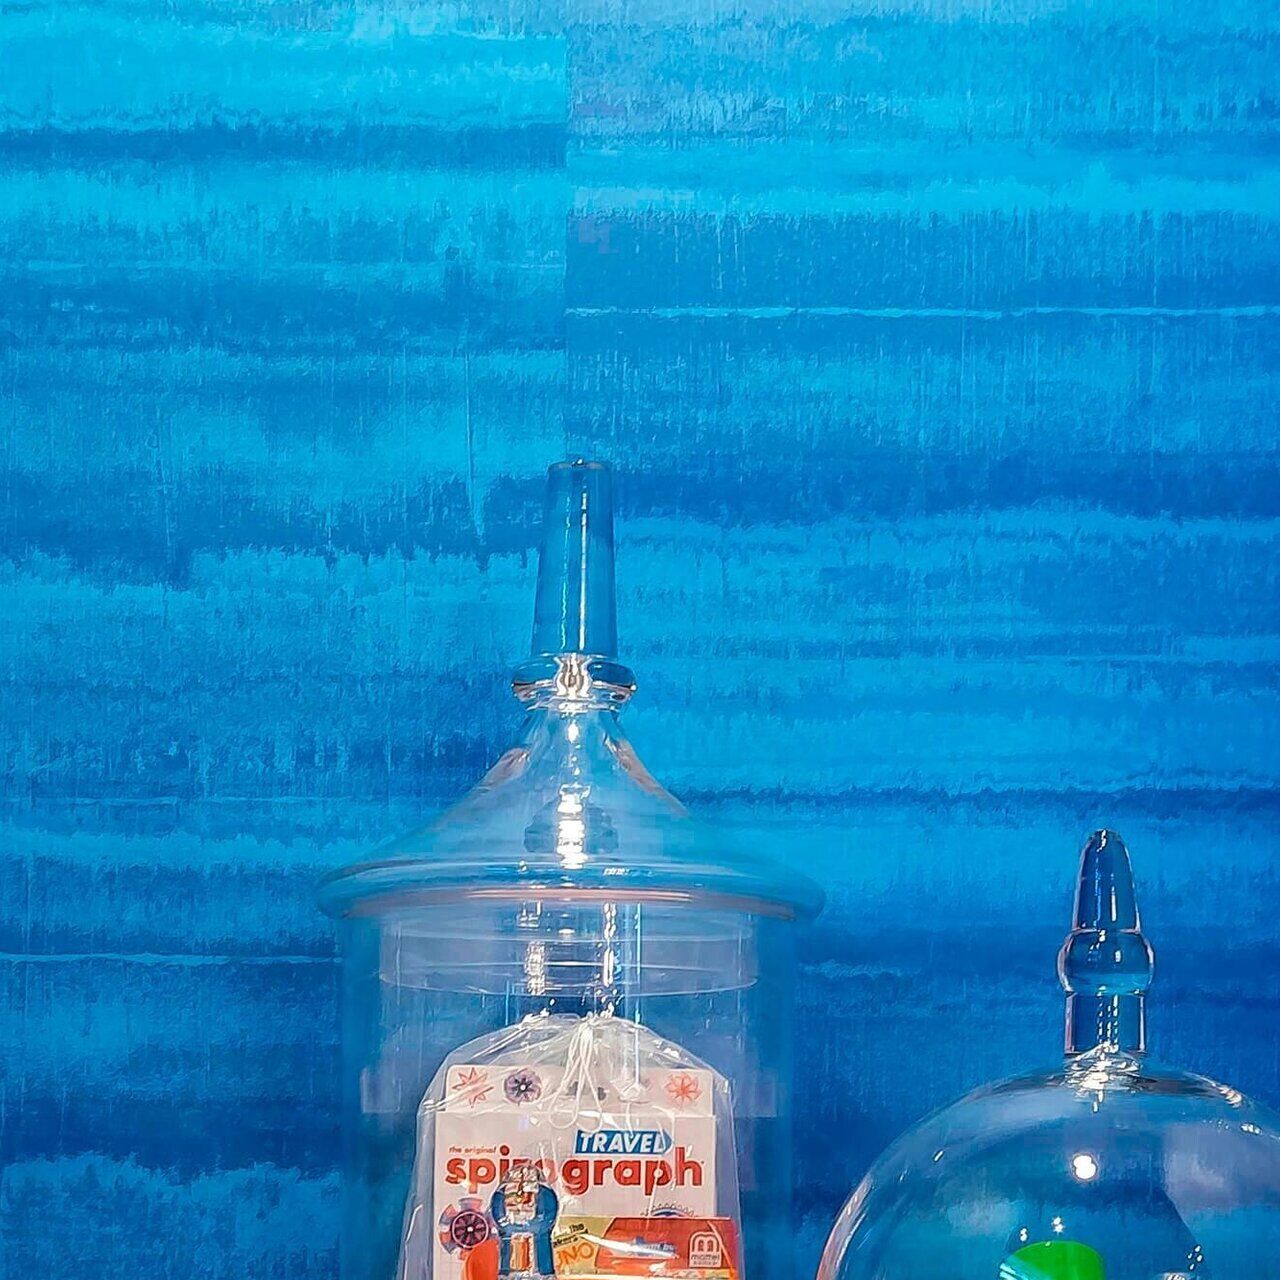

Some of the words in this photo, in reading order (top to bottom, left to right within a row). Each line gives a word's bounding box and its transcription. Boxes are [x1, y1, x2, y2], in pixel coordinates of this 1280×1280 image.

[448, 1145, 463, 1154] the
[464, 1144, 498, 1156] original
[579, 1131, 665, 1154] TRAVEL
